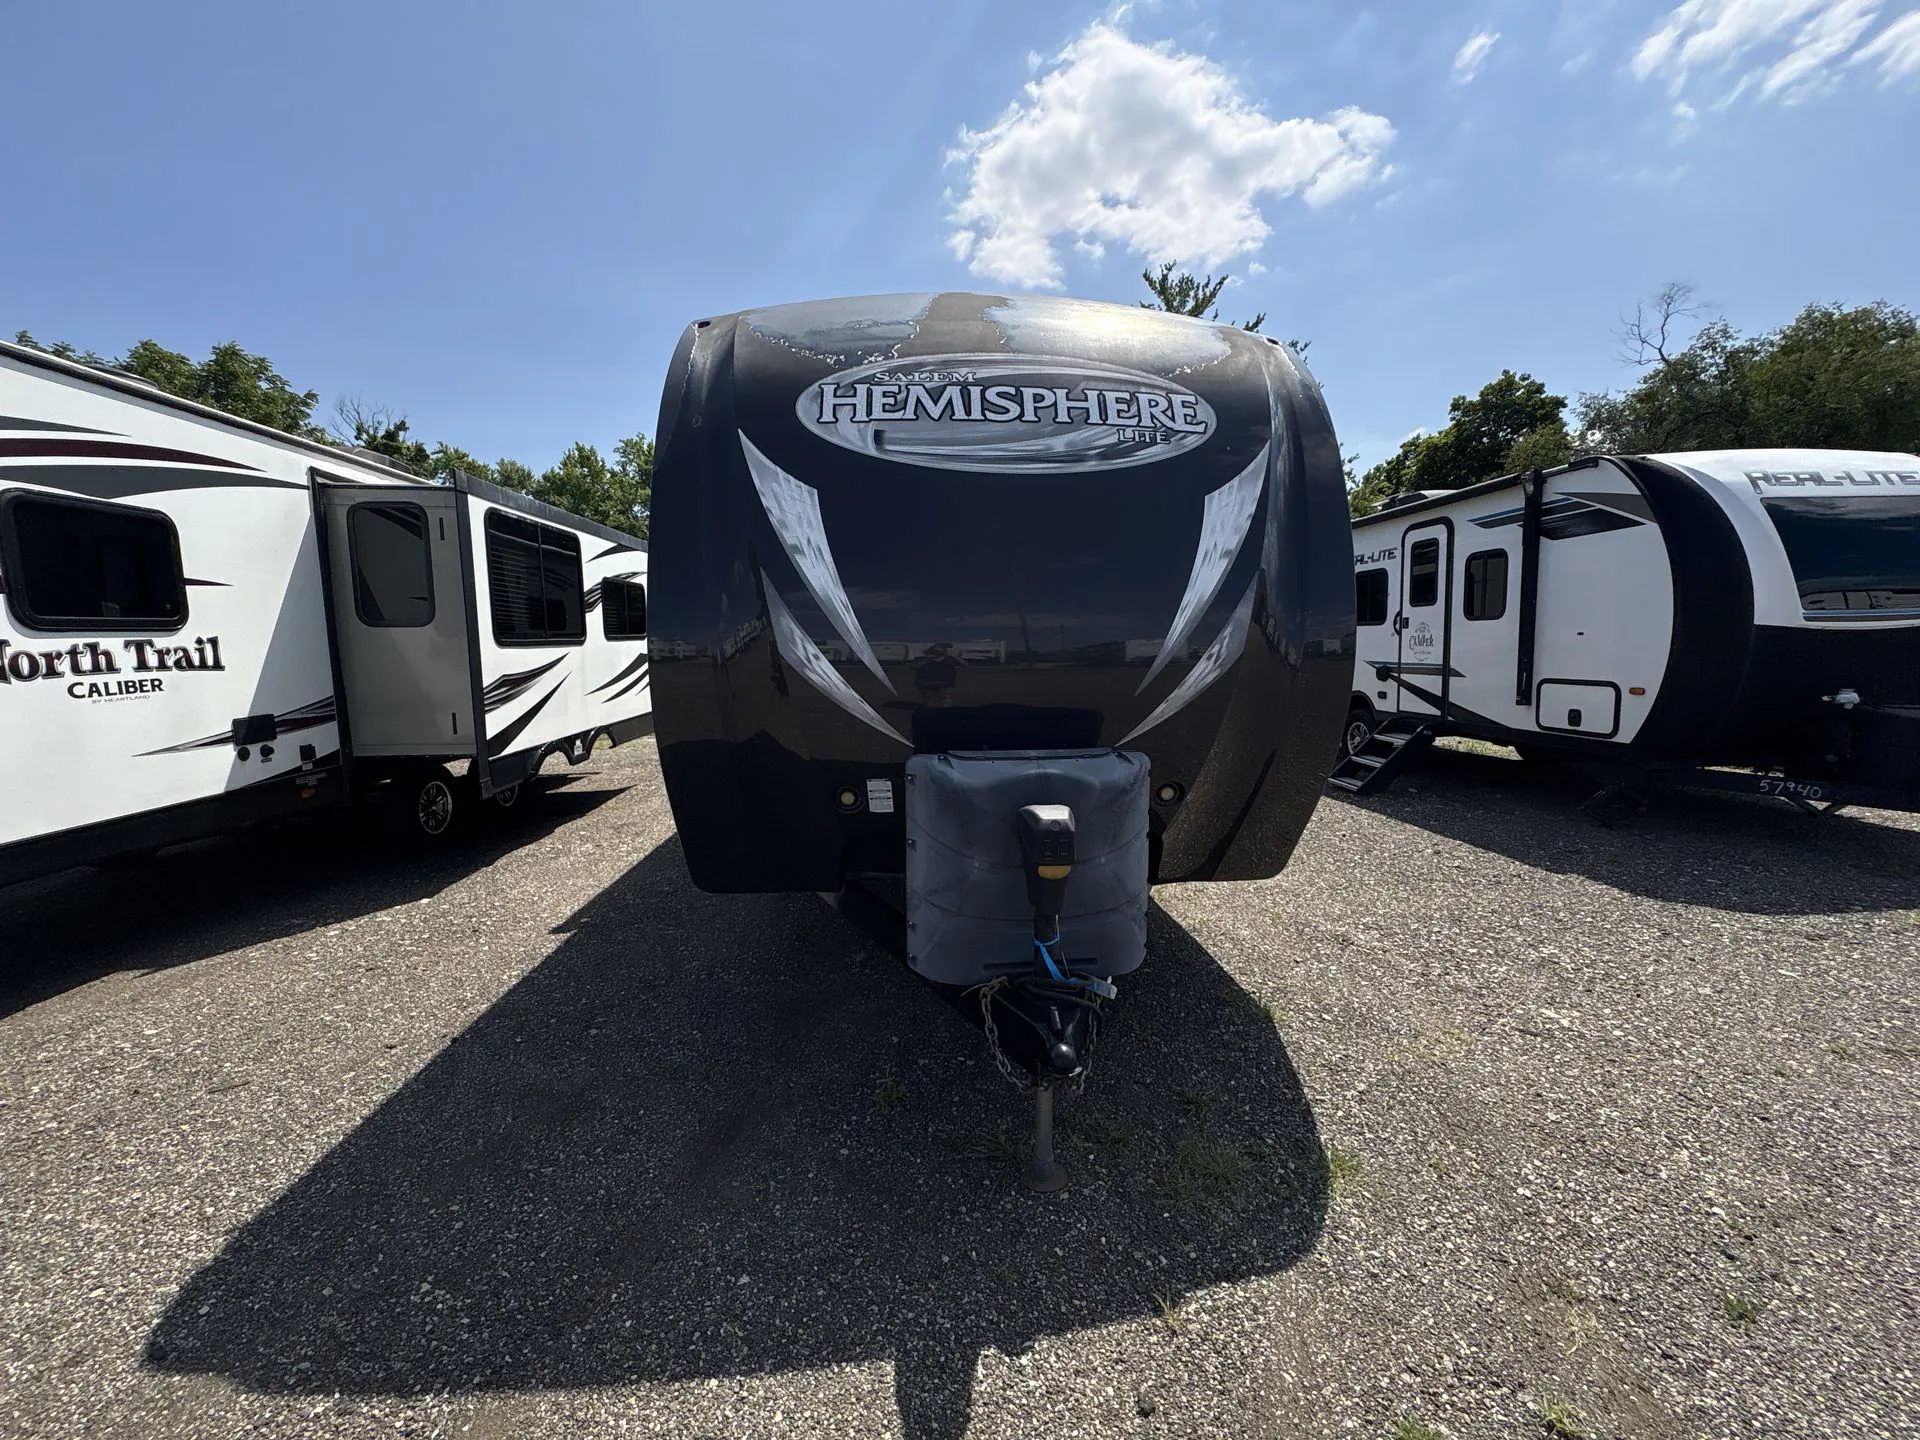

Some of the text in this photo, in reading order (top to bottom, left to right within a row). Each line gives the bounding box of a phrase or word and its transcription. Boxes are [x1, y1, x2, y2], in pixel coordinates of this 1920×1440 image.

[872, 371, 977, 384] SALEM
[816, 382, 1207, 434] HEMISPHERE
[1117, 427, 1171, 445] LITE
[124, 636, 225, 672] Trail
[67, 678, 165, 699] CALIBER
[104, 695, 150, 703] HEARTLAND
[1759, 779, 1822, 799] 57940
